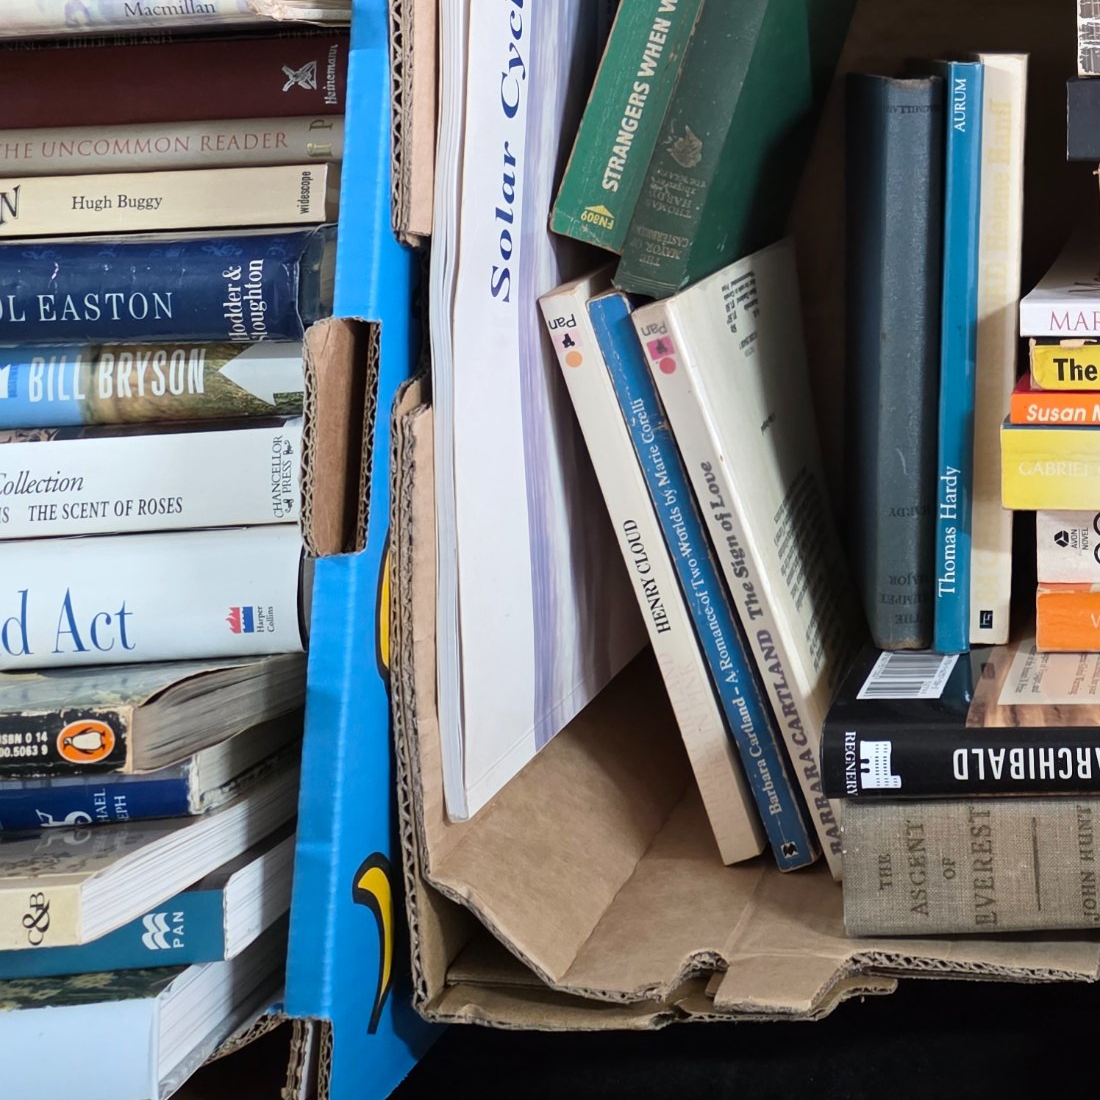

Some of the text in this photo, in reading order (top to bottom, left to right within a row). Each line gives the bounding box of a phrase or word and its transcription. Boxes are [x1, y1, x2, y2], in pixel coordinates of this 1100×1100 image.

[123, 0, 216, 18] Macmillan
[601, 80, 650, 193] STRANGERS
[637, 14, 672, 80] WHEN
[41, 131, 289, 159] UNCOMMON READER
[72, 193, 163, 212] Hugh Buggy
[299, 170, 311, 215] widescope
[489, 140, 518, 303] Solar
[38, 291, 174, 323] EASTON
[640, 322, 669, 338] Pan
[937, 77, 968, 599] Thomas Hardy AURUM
[28, 348, 207, 403] BILL BRYSON
[1052, 357, 1098, 382] The
[1026, 403, 1087, 423] Susan
[271, 434, 283, 520] CHANCELLOR
[28, 495, 184, 522] THE SCENT OF ROSES
[621, 518, 672, 635] HENRY CLOUD
[51, 588, 137, 655] Act
[843, 731, 859, 797] REGNERY
[172, 910, 186, 949] PAN
